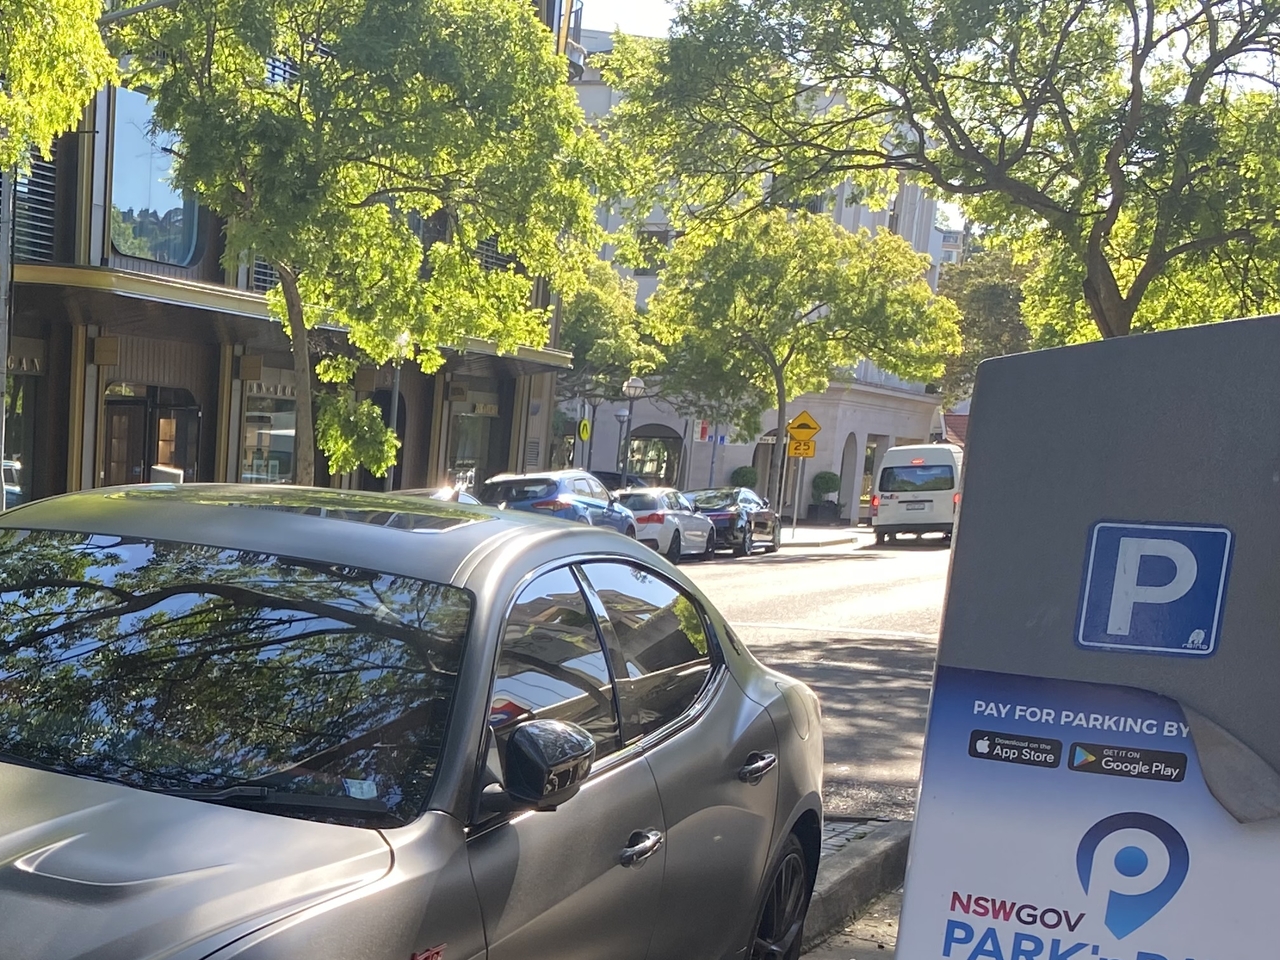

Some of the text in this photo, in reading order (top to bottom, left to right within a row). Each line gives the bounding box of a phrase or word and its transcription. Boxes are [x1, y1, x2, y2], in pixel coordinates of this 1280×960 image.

[794, 441, 811, 451] 25
[1106, 537, 1198, 636] P
[973, 700, 1190, 738] PAY FOR PARKING BY
[995, 737, 1028, 748] Download
[993, 745, 1055, 763] App Store
[1103, 748, 1141, 759] GET IT ON
[1101, 757, 1180, 780] Google Play
[949, 891, 1086, 933] NSWGOV
